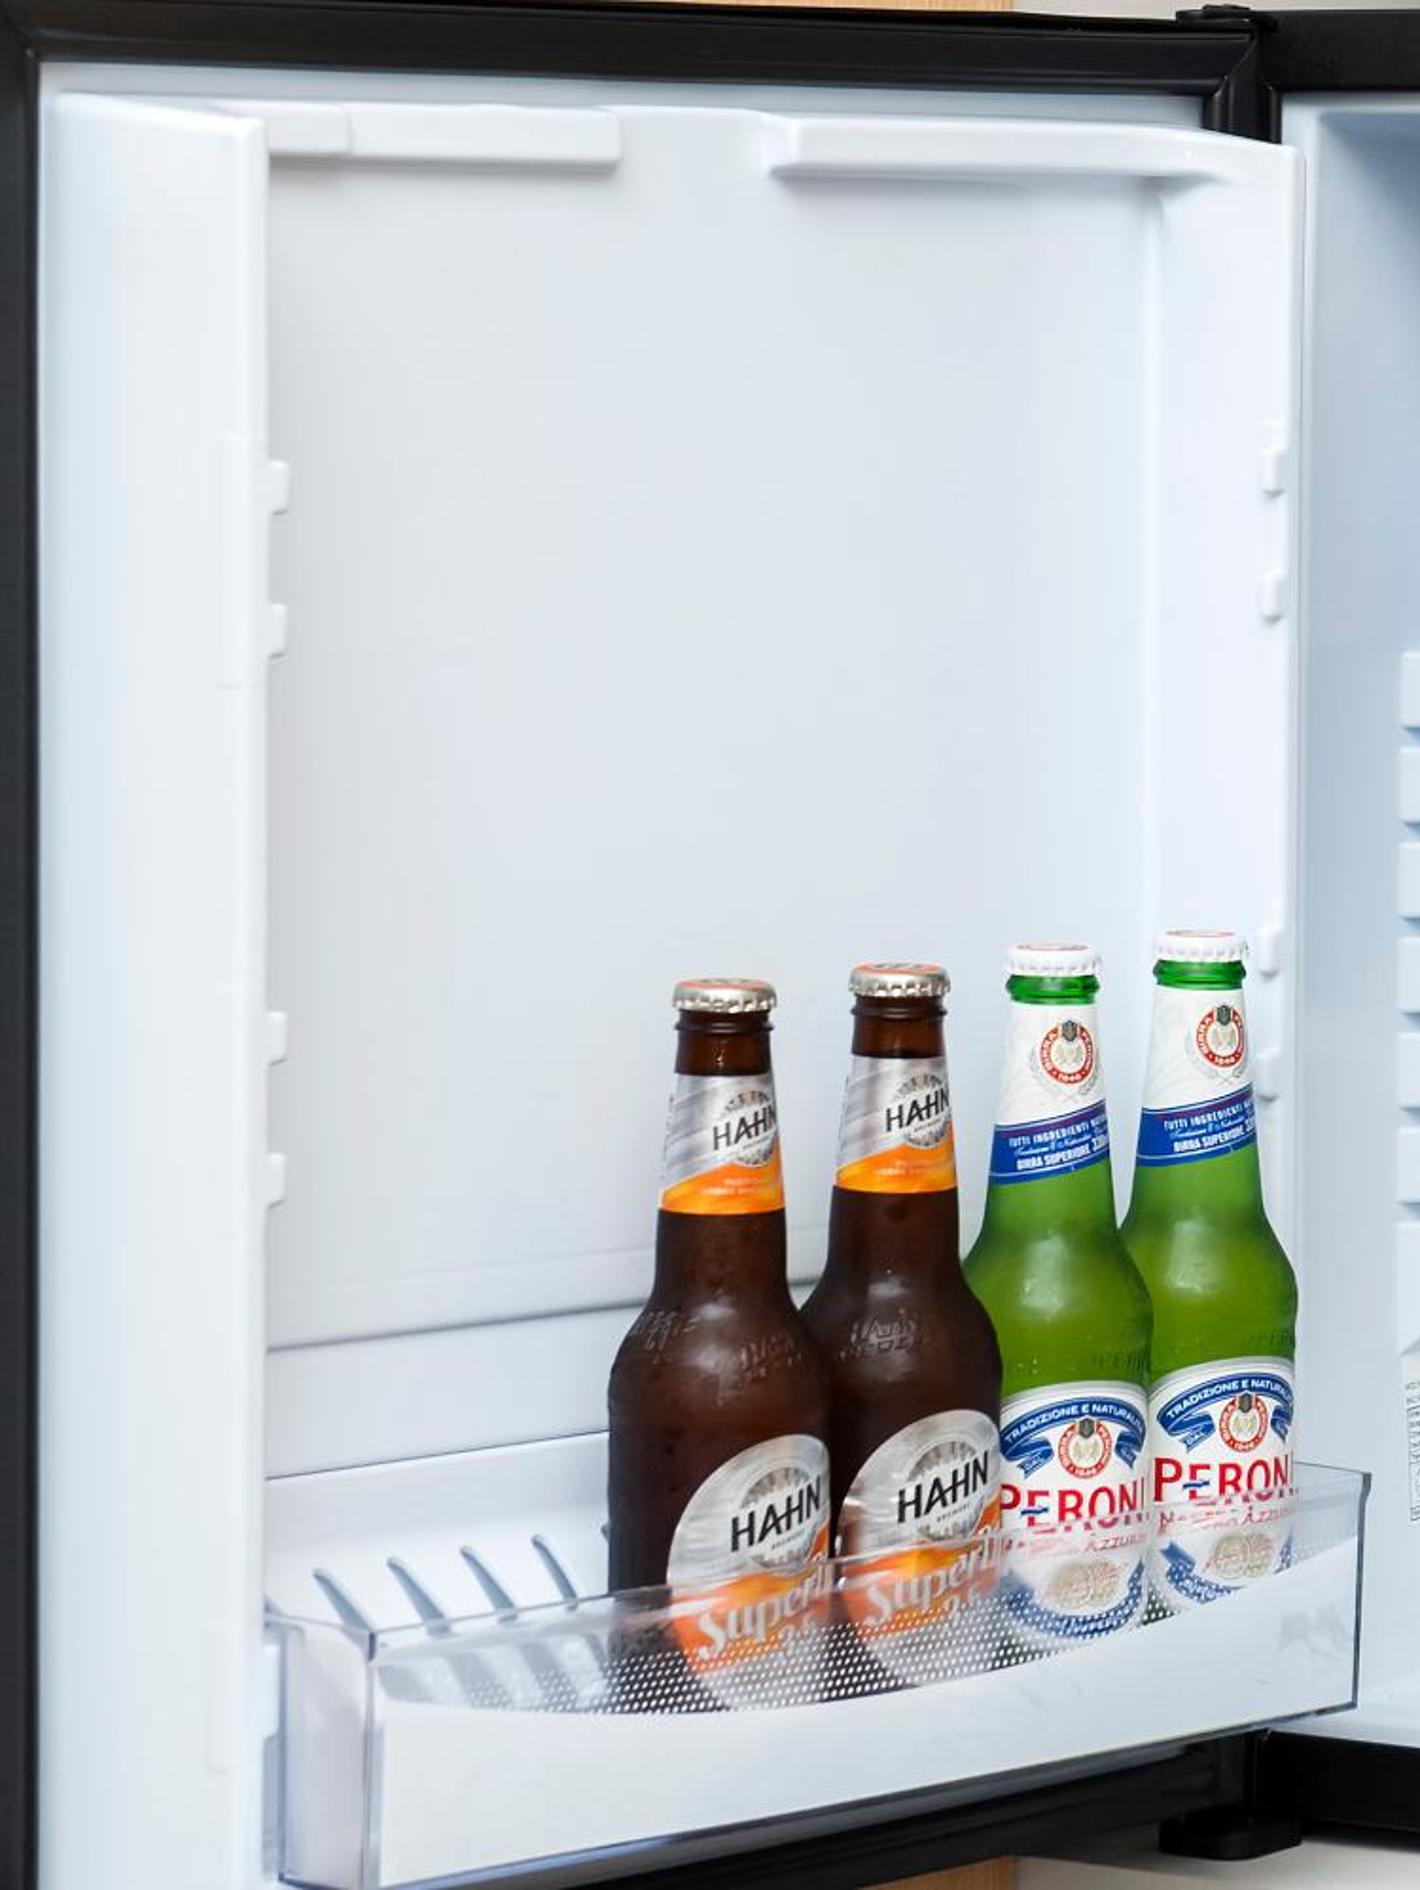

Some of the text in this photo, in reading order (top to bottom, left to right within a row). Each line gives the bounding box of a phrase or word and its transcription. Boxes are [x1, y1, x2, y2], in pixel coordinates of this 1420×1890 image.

[886, 1087, 949, 1132] HAHN
[1004, 1404, 1080, 1443] TRADIZIONE
[1081, 1403, 1090, 1413] E
[1167, 1381, 1239, 1419] TRADIZIONE
[1241, 1380, 1250, 1389] E
[897, 1452, 990, 1524] HAHN
[1154, 1451, 1296, 1504] PERONI
[731, 1475, 821, 1552] HAHN
[1000, 1476, 1149, 1533] PERONI
